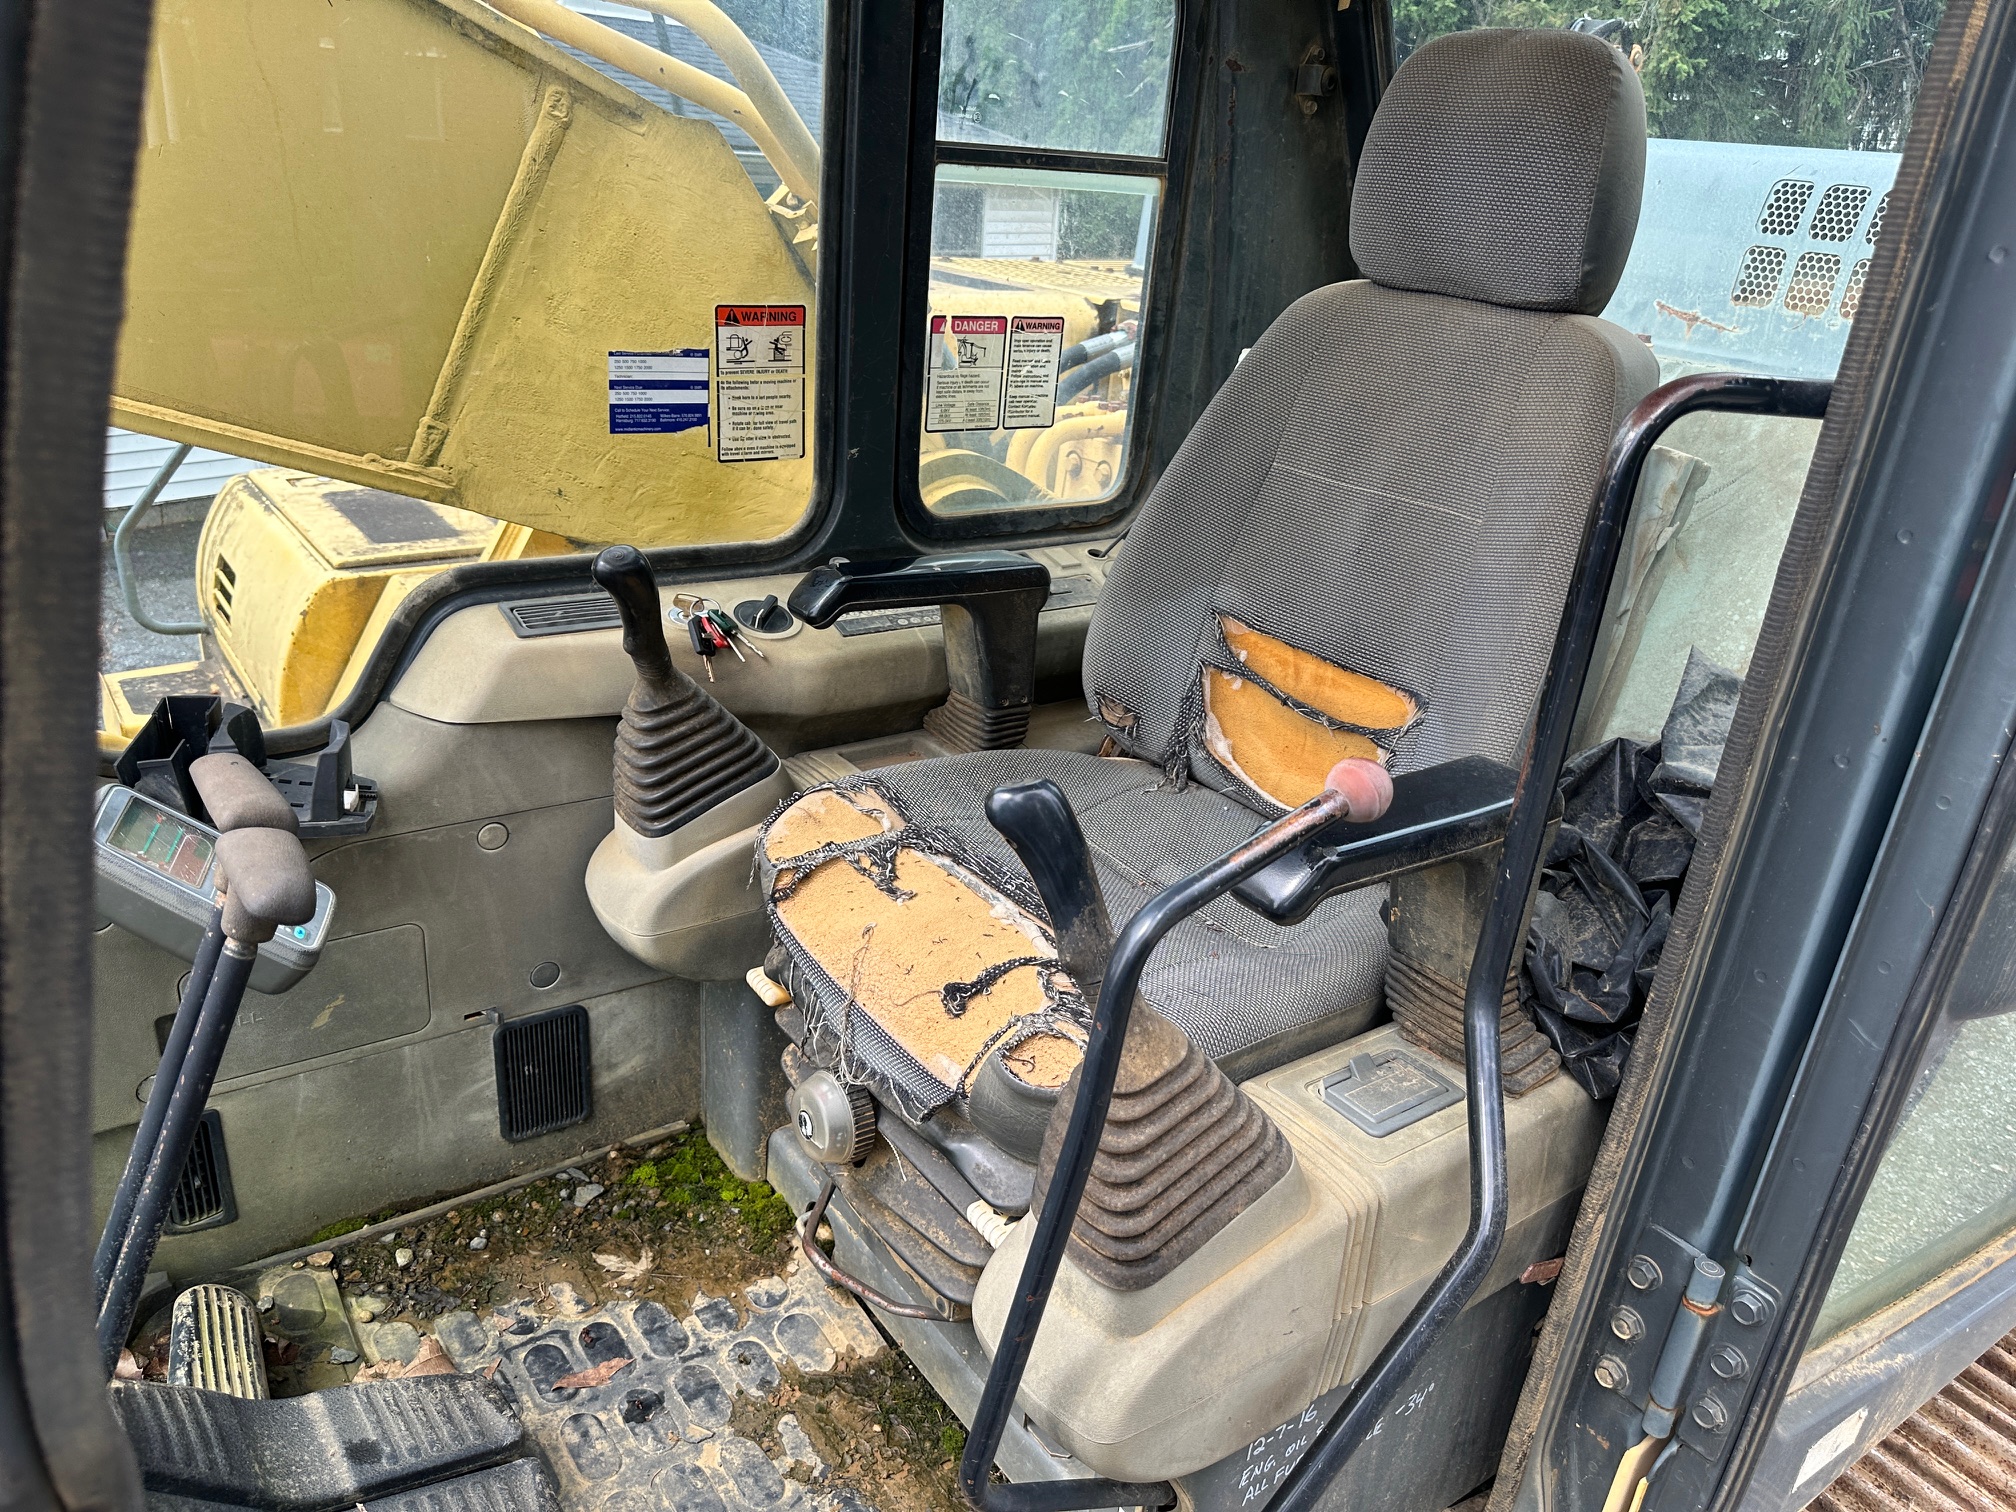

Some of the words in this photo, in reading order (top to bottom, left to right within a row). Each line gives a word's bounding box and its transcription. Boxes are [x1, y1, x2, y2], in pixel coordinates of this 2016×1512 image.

[741, 312, 797, 322] WARNING
[955, 321, 998, 332] DANGER
[1026, 322, 1060, 330] WARNING
[1241, 1478, 1269, 1507] ALL
